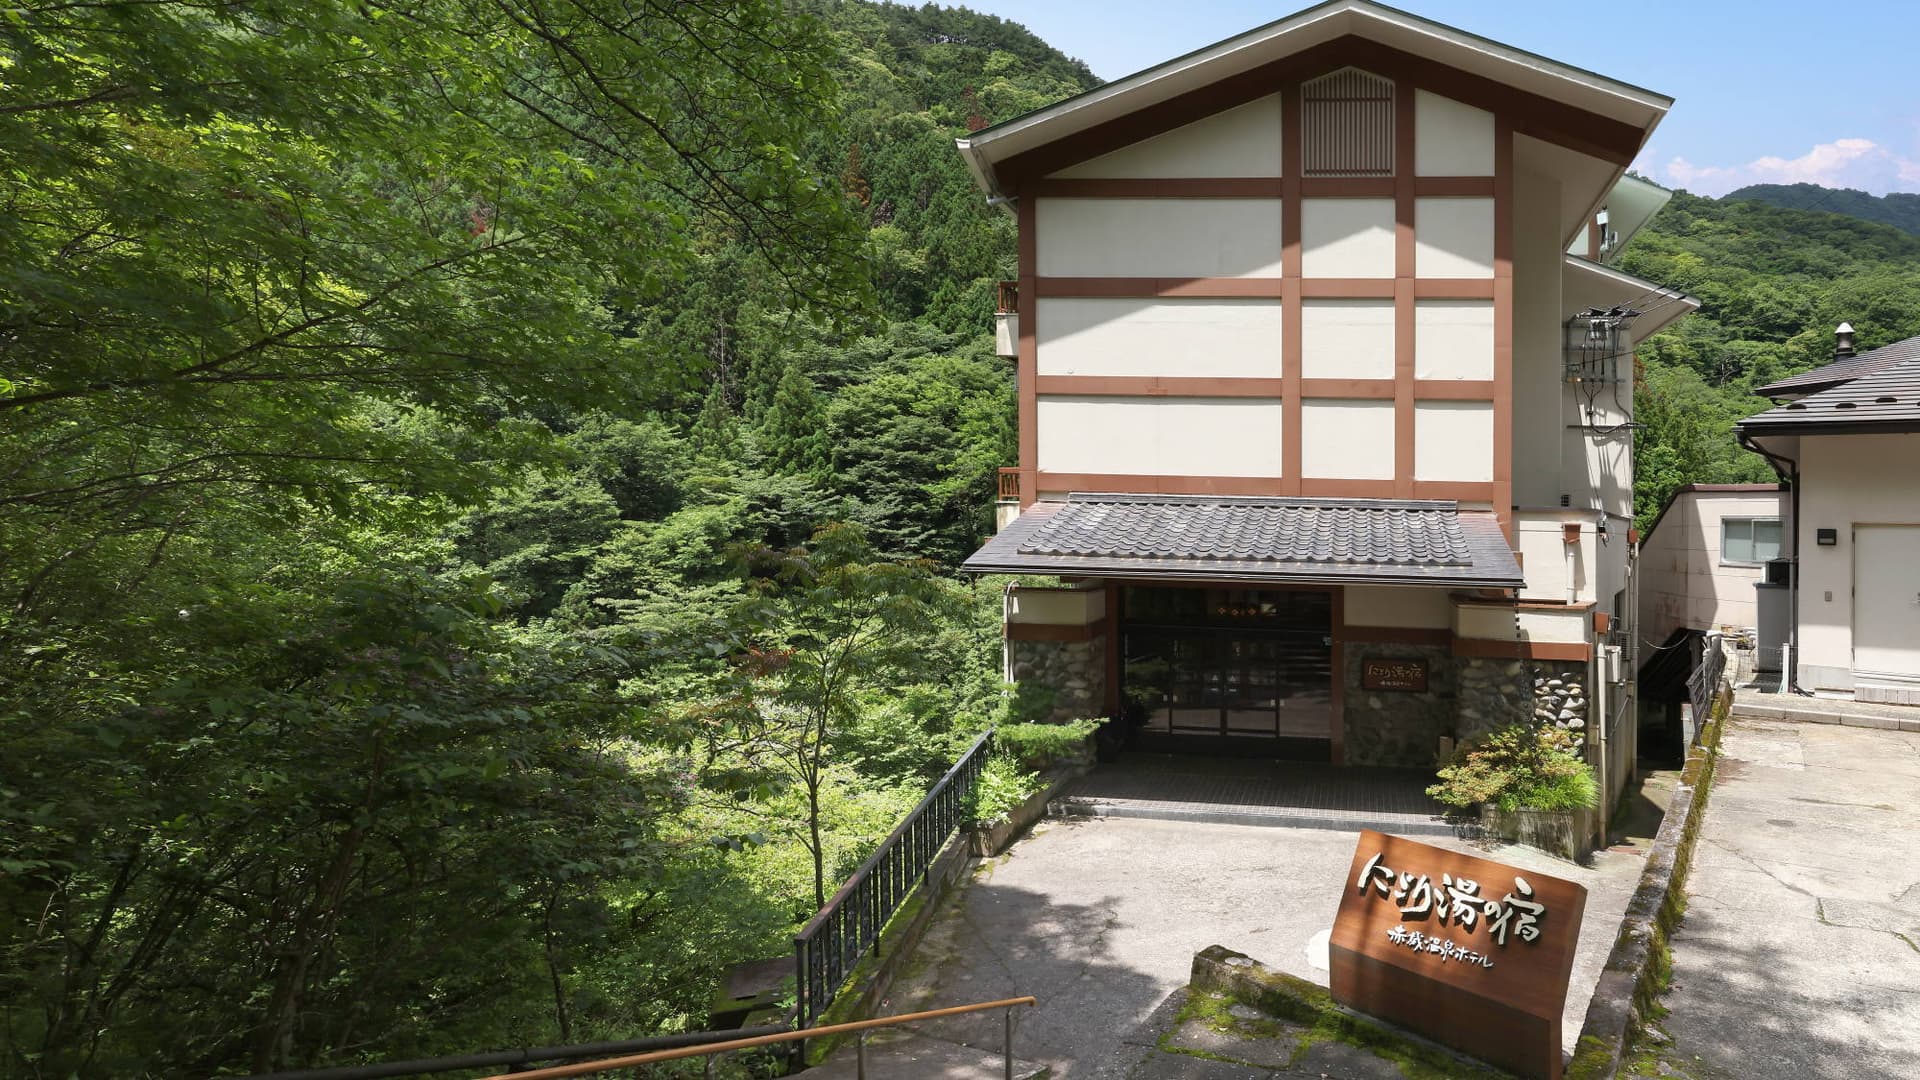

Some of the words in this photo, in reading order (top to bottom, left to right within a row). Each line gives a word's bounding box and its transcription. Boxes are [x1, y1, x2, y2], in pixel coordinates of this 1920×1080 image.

[1386, 924, 1494, 968] 赤城温泉ホテル
